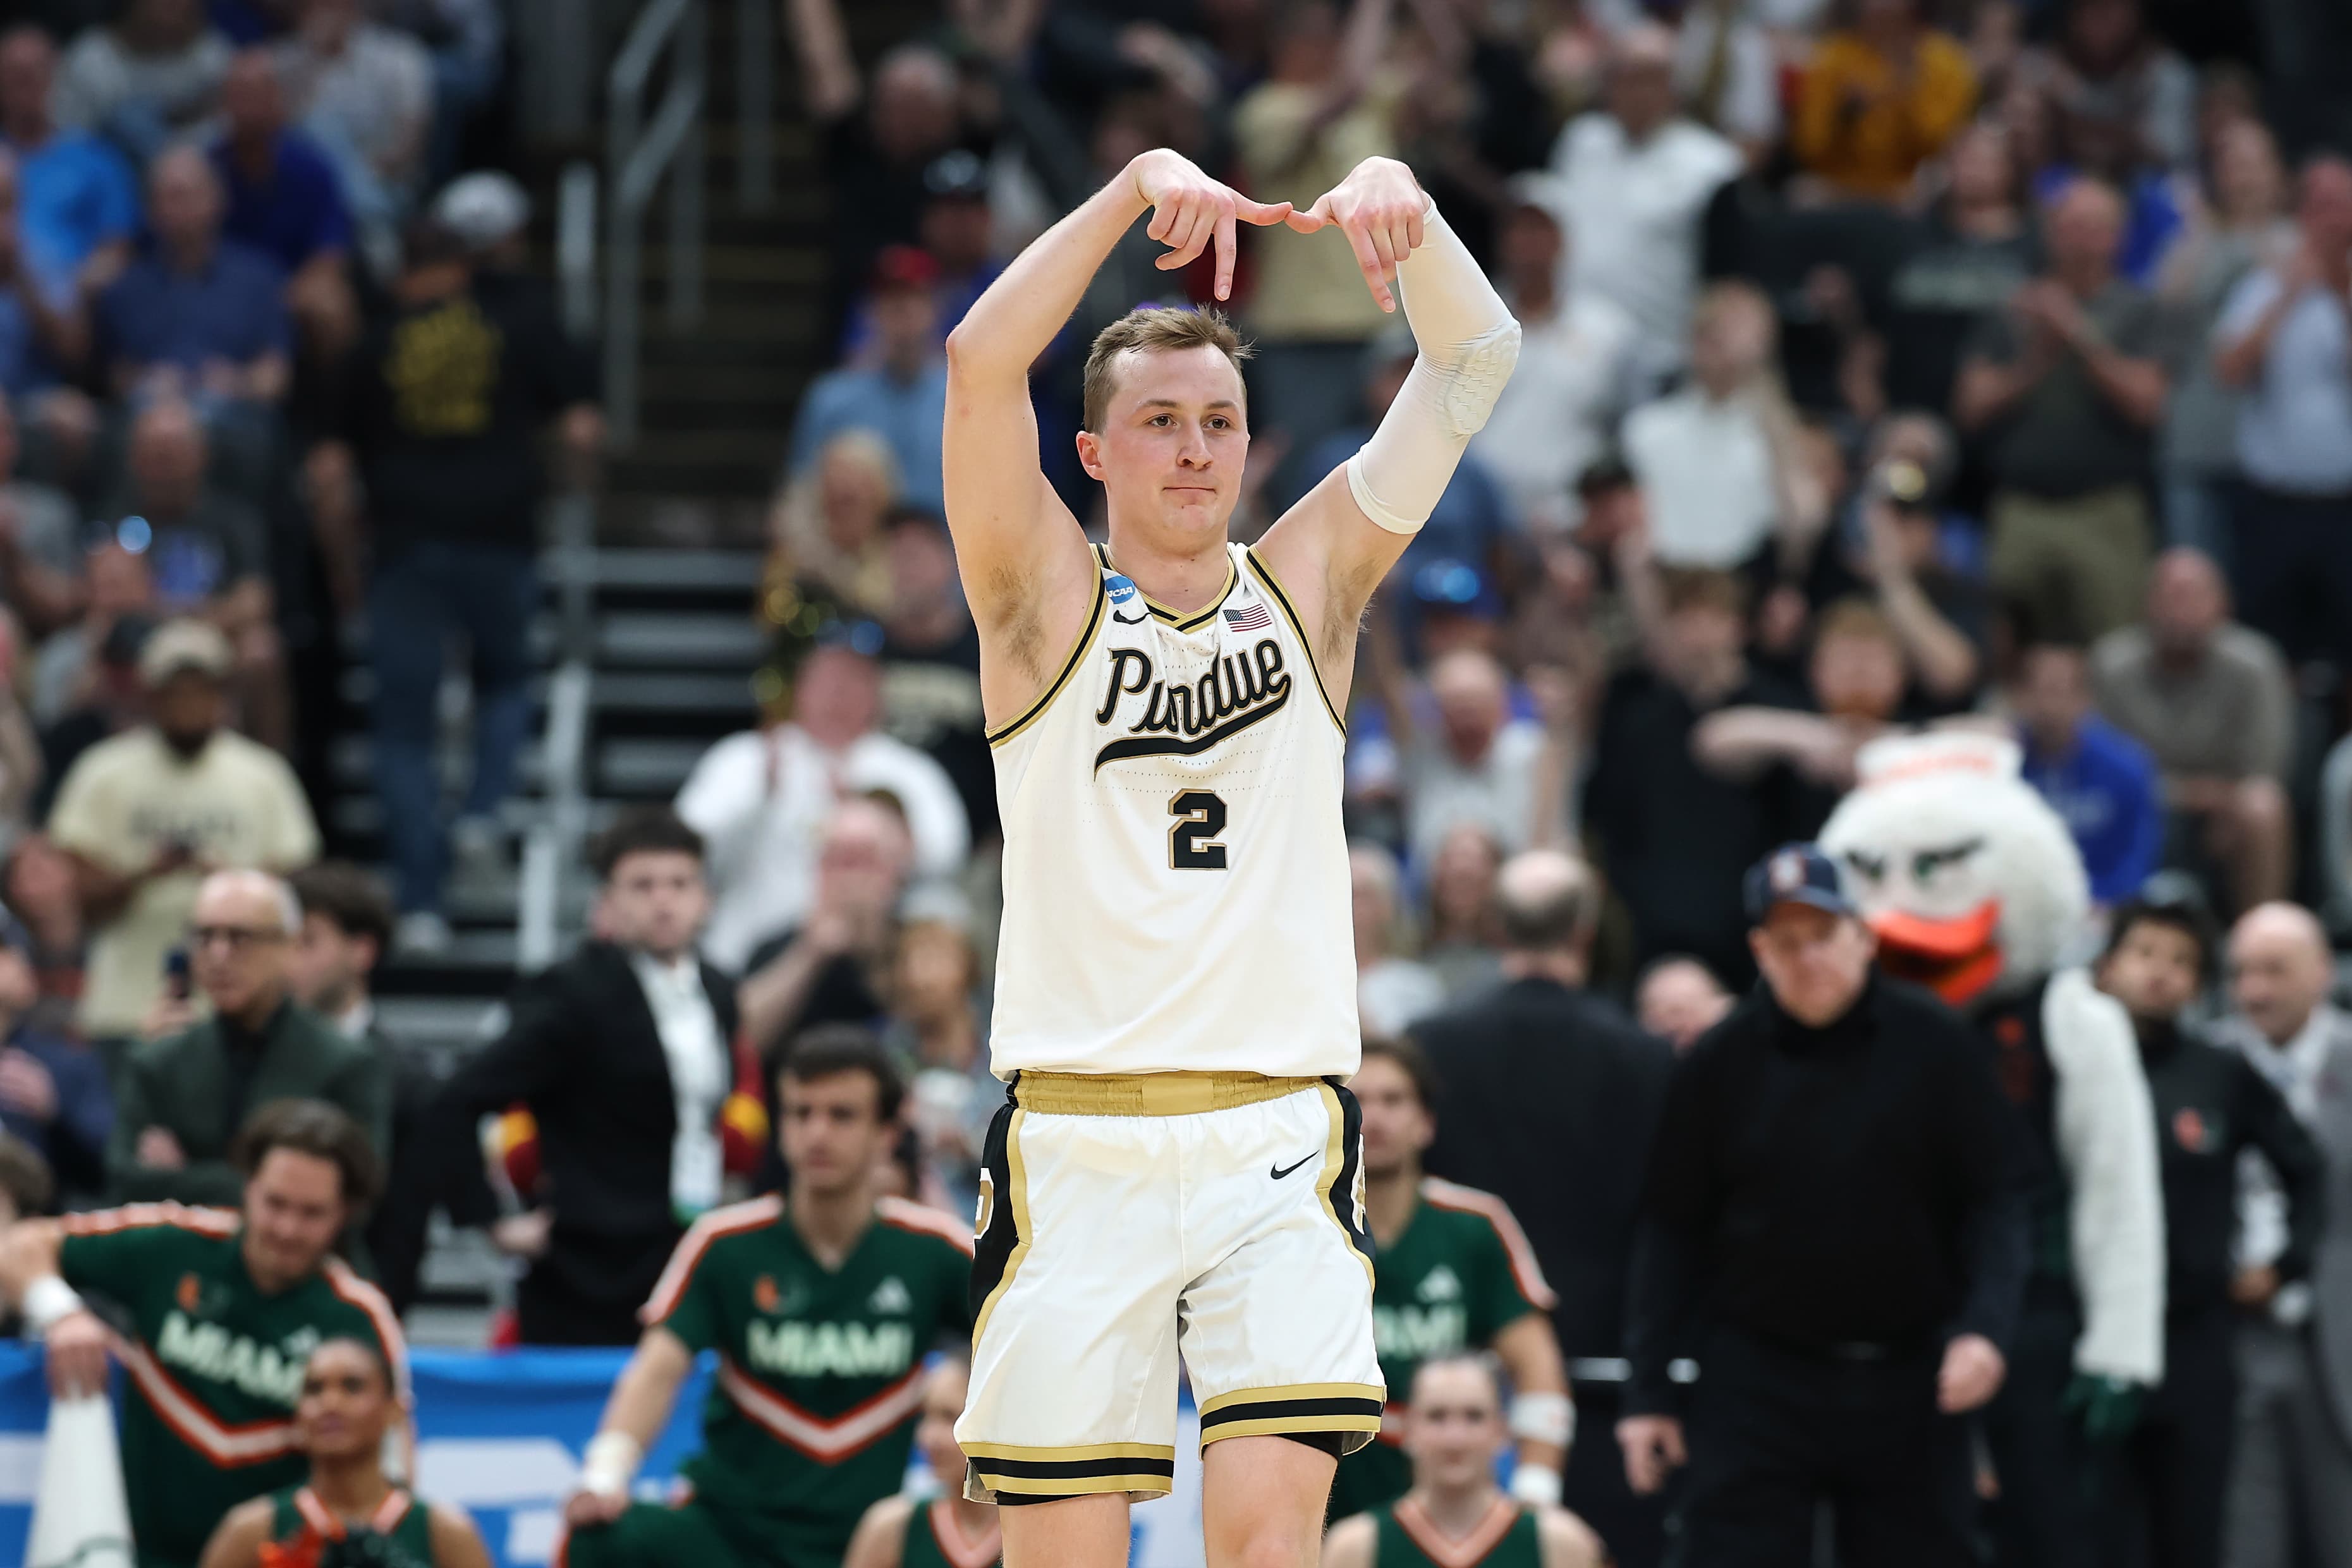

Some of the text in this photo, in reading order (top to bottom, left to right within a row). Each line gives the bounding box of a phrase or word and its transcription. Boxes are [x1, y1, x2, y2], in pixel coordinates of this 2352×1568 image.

[1094, 638, 1292, 736] Purdue
[1167, 788, 1228, 870] 2
[159, 1310, 307, 1404] MIAM
[747, 1319, 915, 1377] MIAMI
